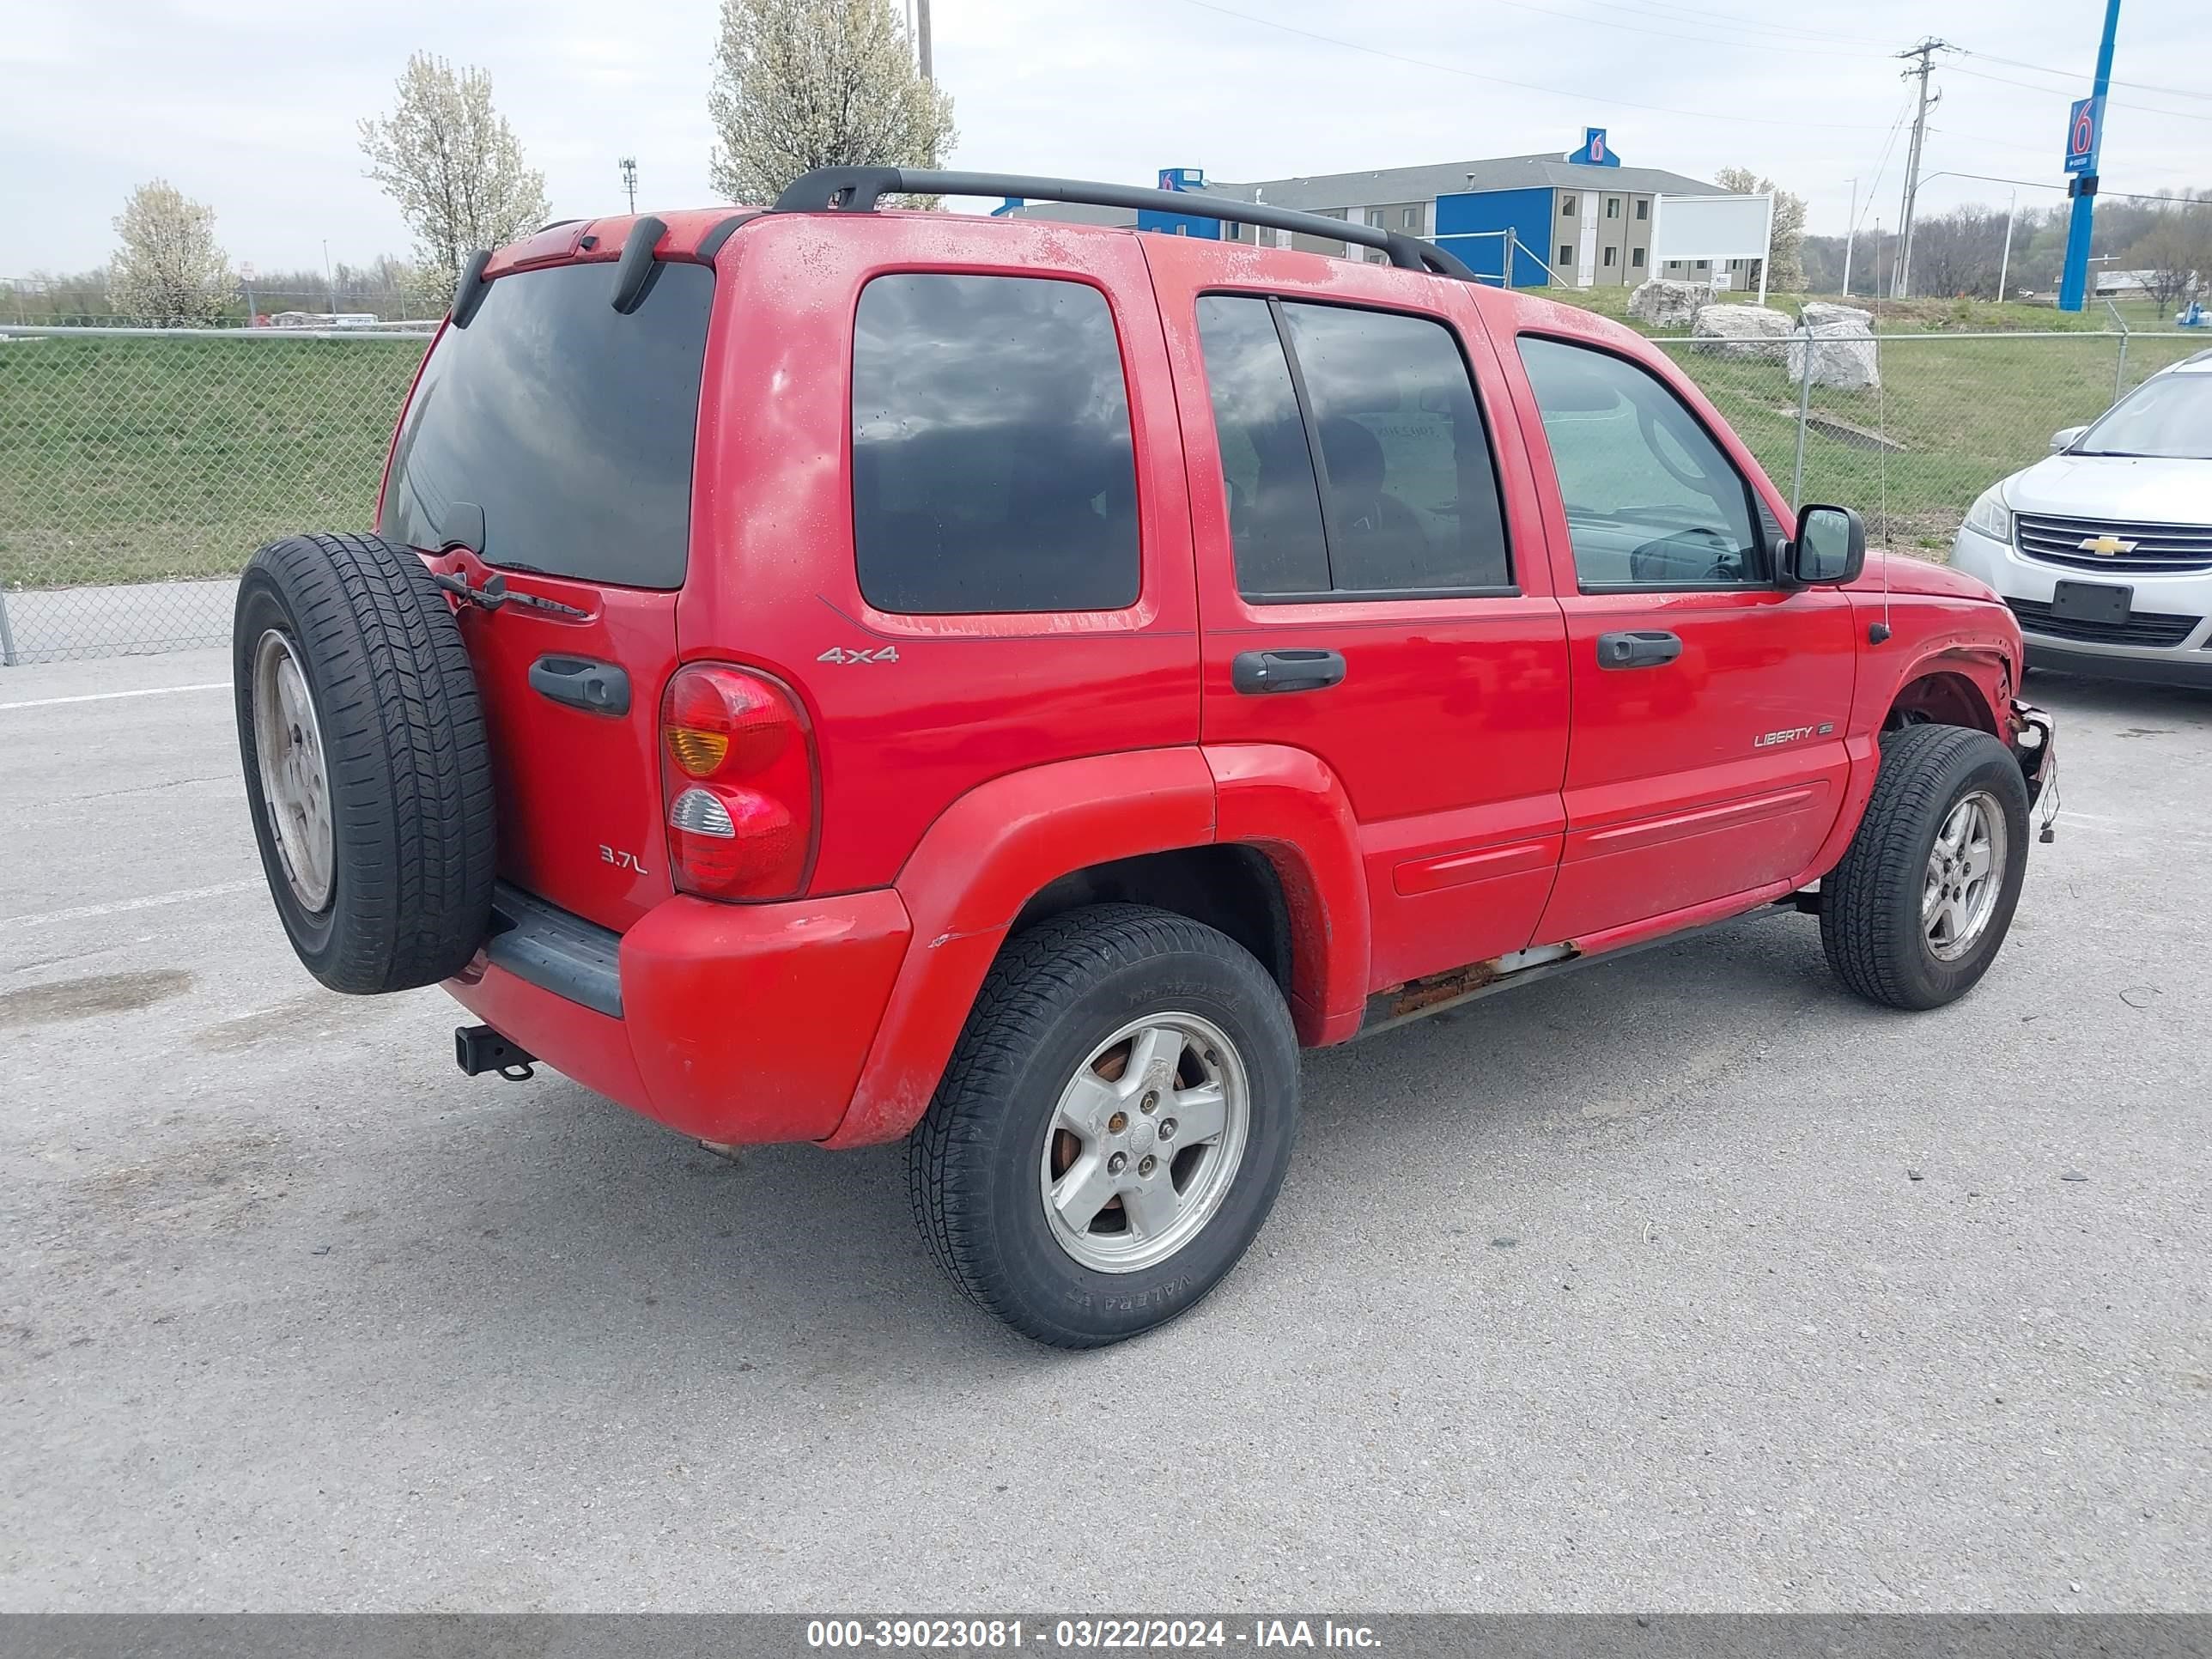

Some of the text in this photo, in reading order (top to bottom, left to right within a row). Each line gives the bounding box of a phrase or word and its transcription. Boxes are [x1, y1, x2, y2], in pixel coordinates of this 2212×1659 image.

[2072, 100, 2093, 155] 6
[1591, 134, 1603, 161] 6
[1754, 726, 1814, 747] LIBERTY
[599, 844, 647, 874] 3.7L
[1105, 1273, 1191, 1311] VALERA
